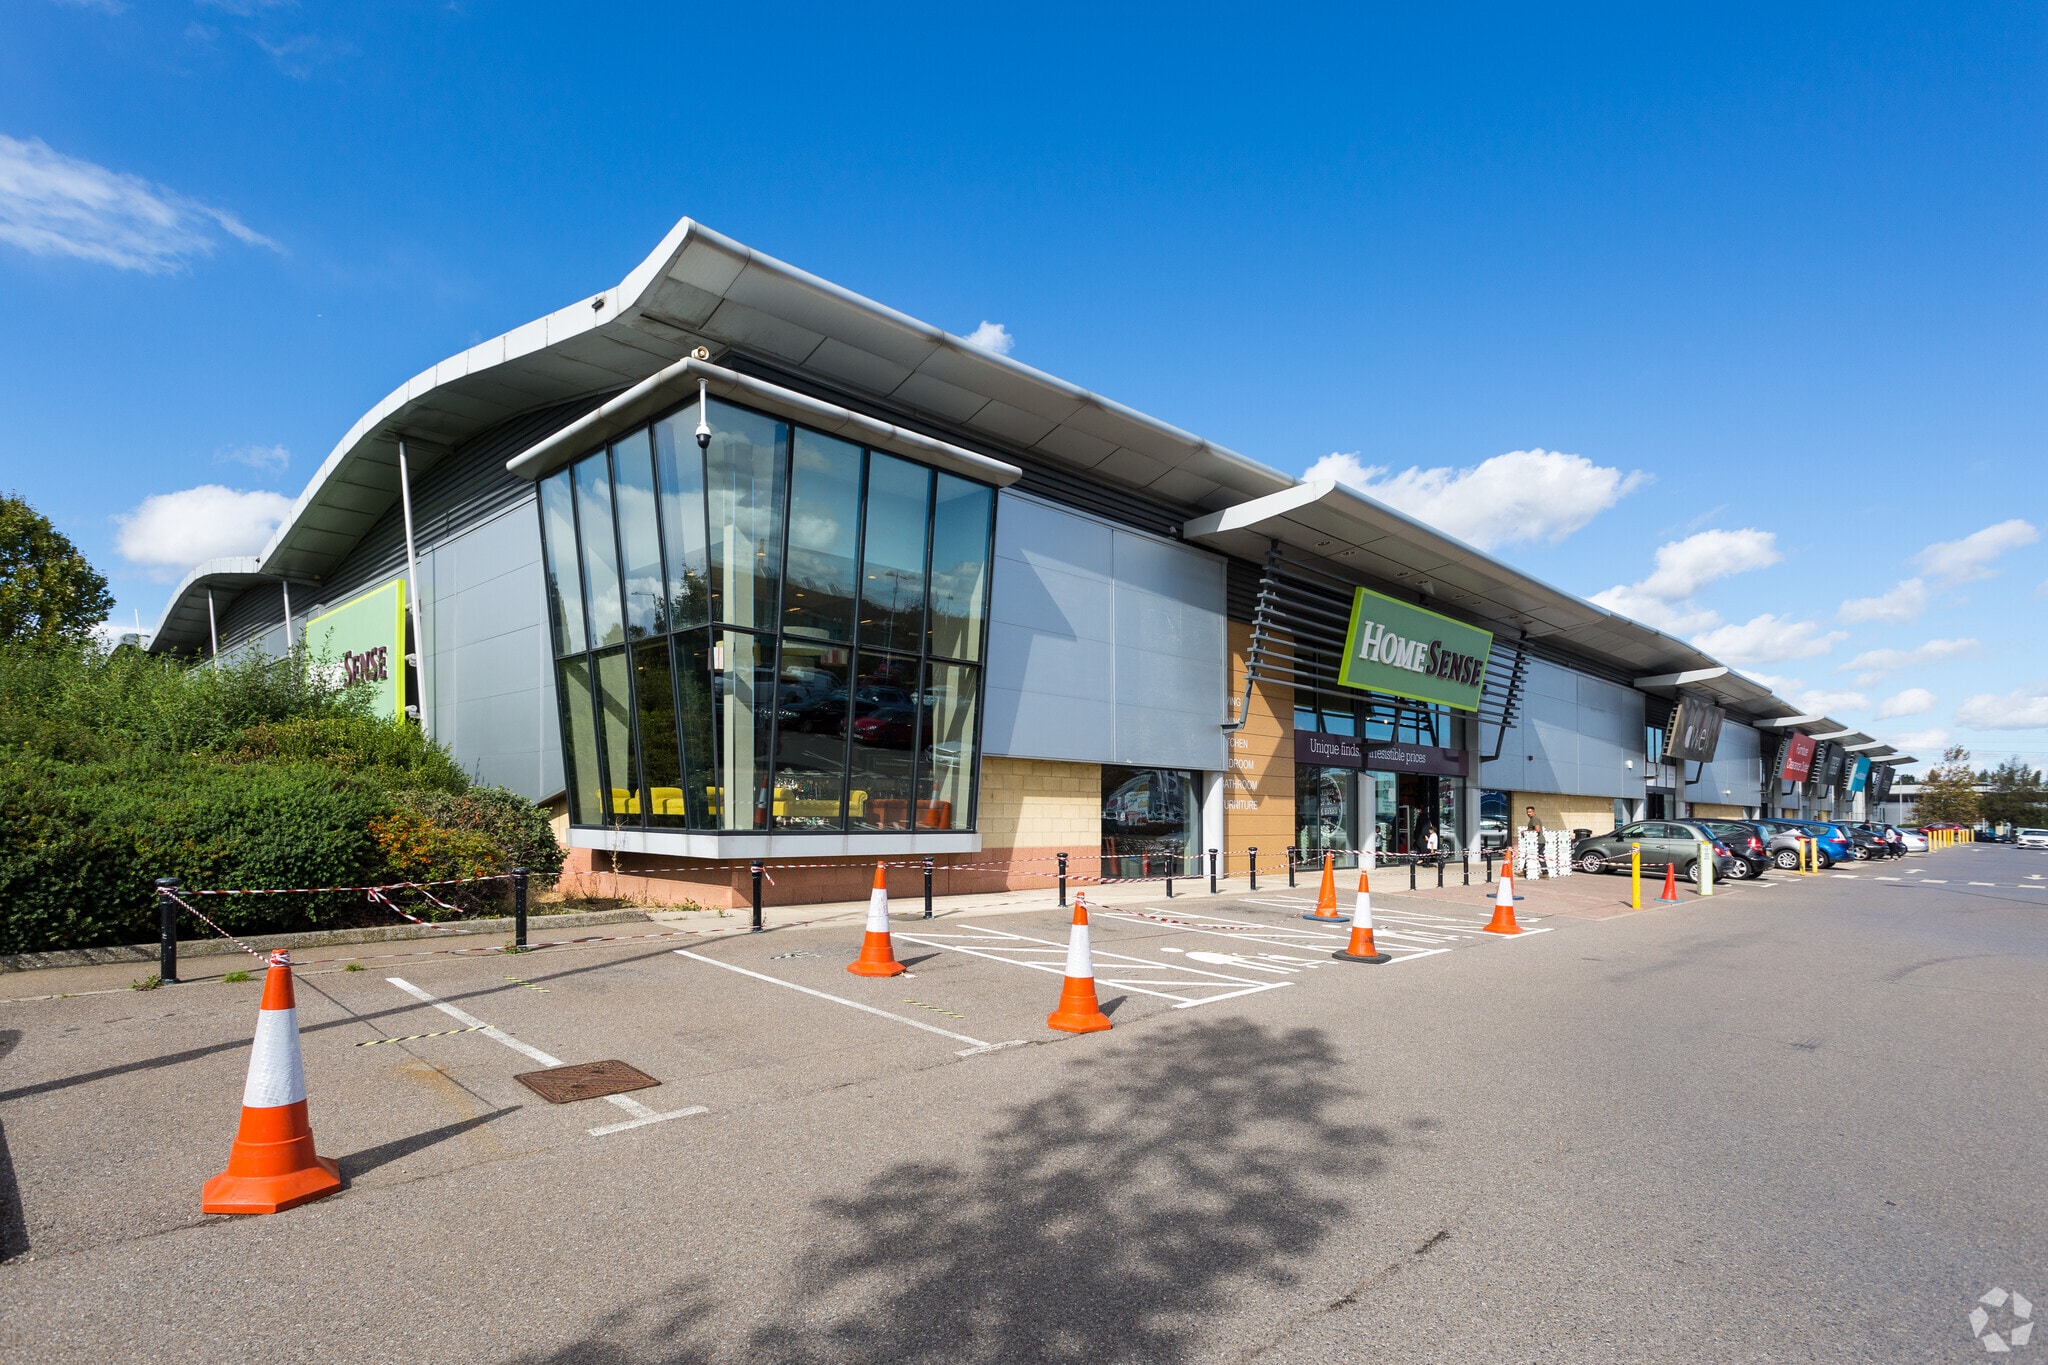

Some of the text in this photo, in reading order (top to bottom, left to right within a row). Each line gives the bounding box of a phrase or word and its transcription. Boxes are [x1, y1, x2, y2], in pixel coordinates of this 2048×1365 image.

[1358, 620, 1484, 687] HOMESENSE
[1309, 737, 1339, 758] Unique
[1406, 752, 1427, 765] prices
[1224, 799, 1258, 811] URNITURE
